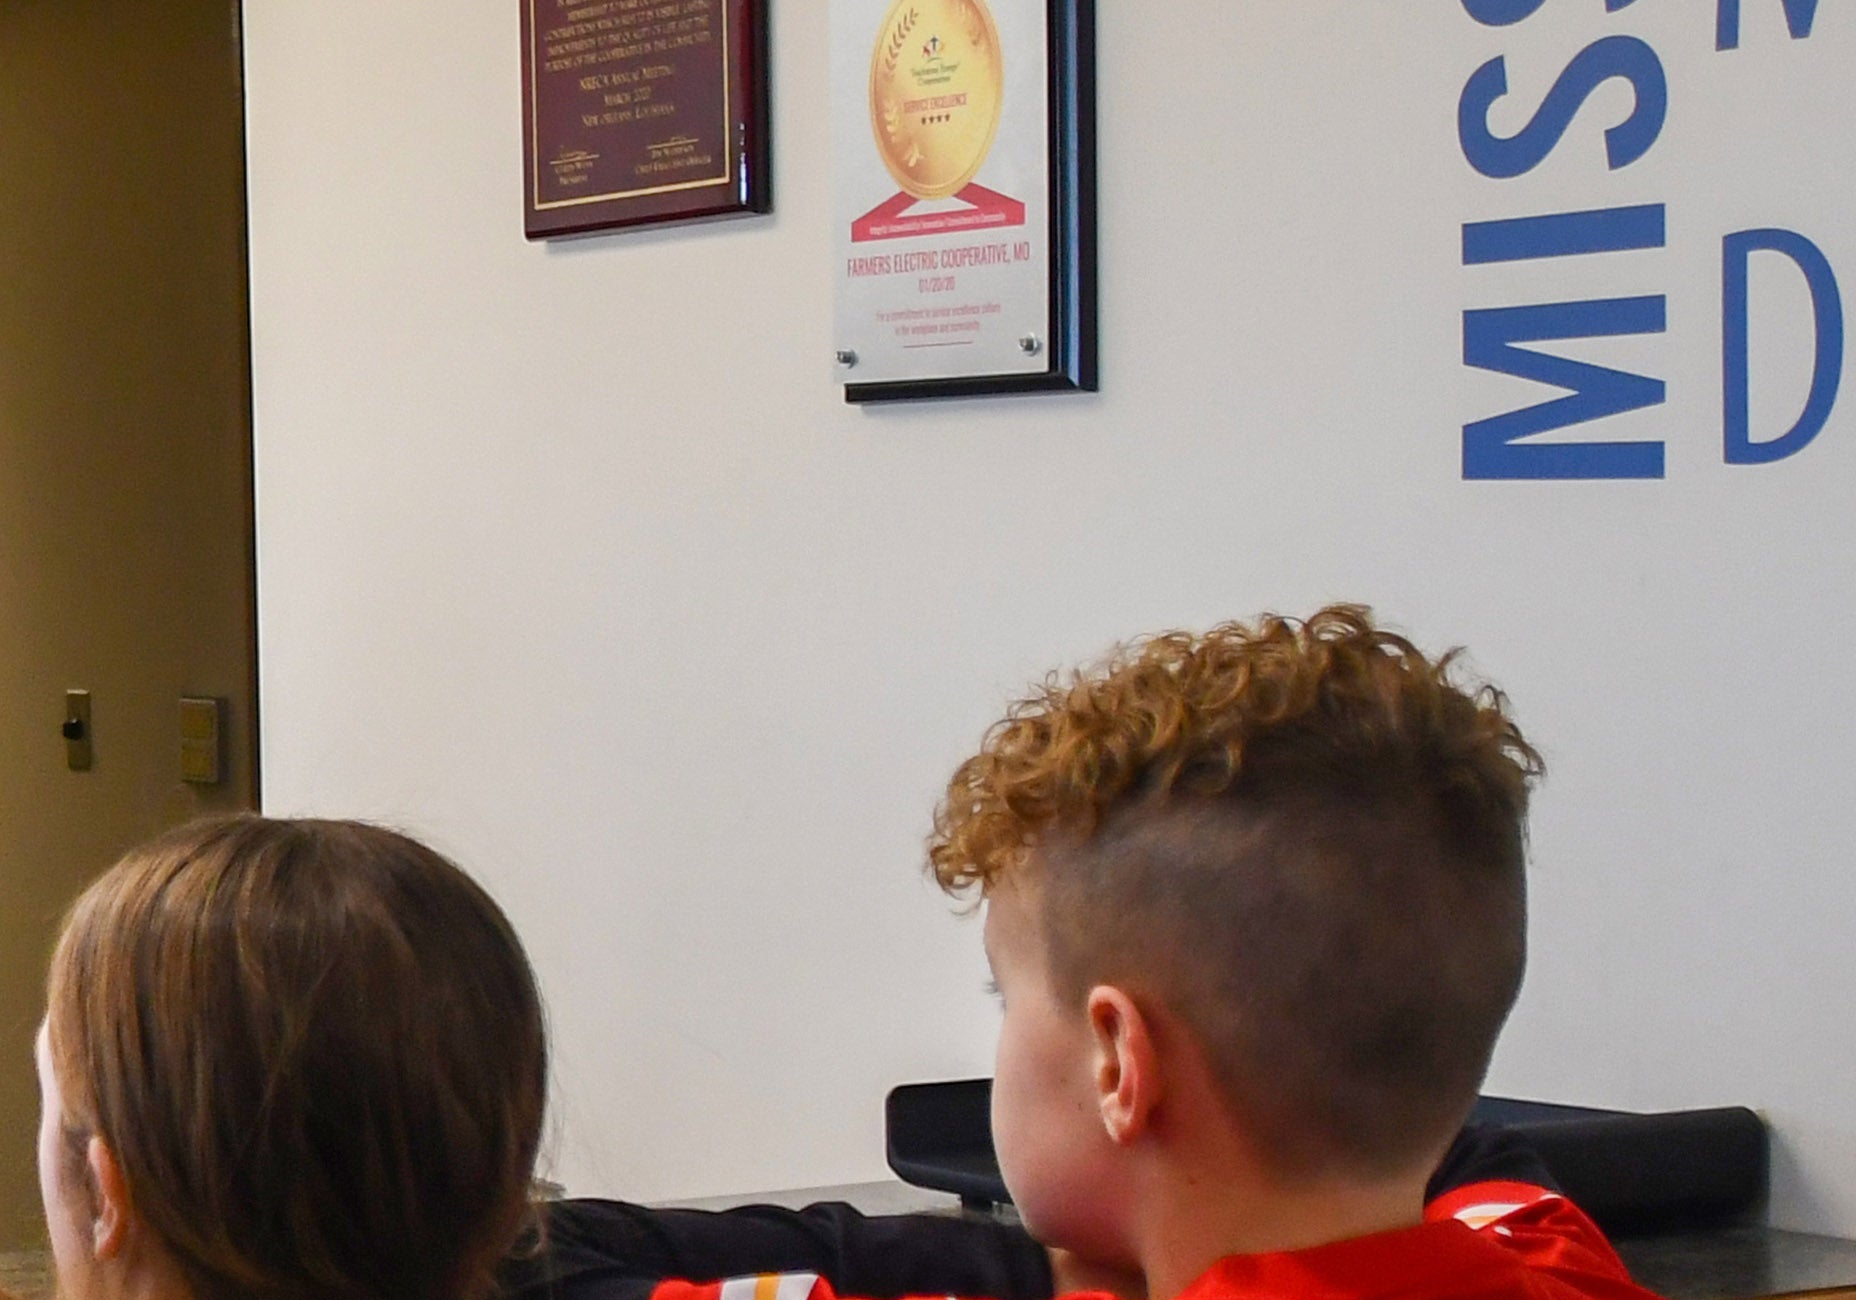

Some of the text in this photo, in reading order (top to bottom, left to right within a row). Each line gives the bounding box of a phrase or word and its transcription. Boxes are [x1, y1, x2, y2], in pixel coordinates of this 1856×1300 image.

[847, 241, 1030, 278] FARMERS ELECTRIC COOPERATIVE, MO
[1458, 0, 1667, 480] MIS
